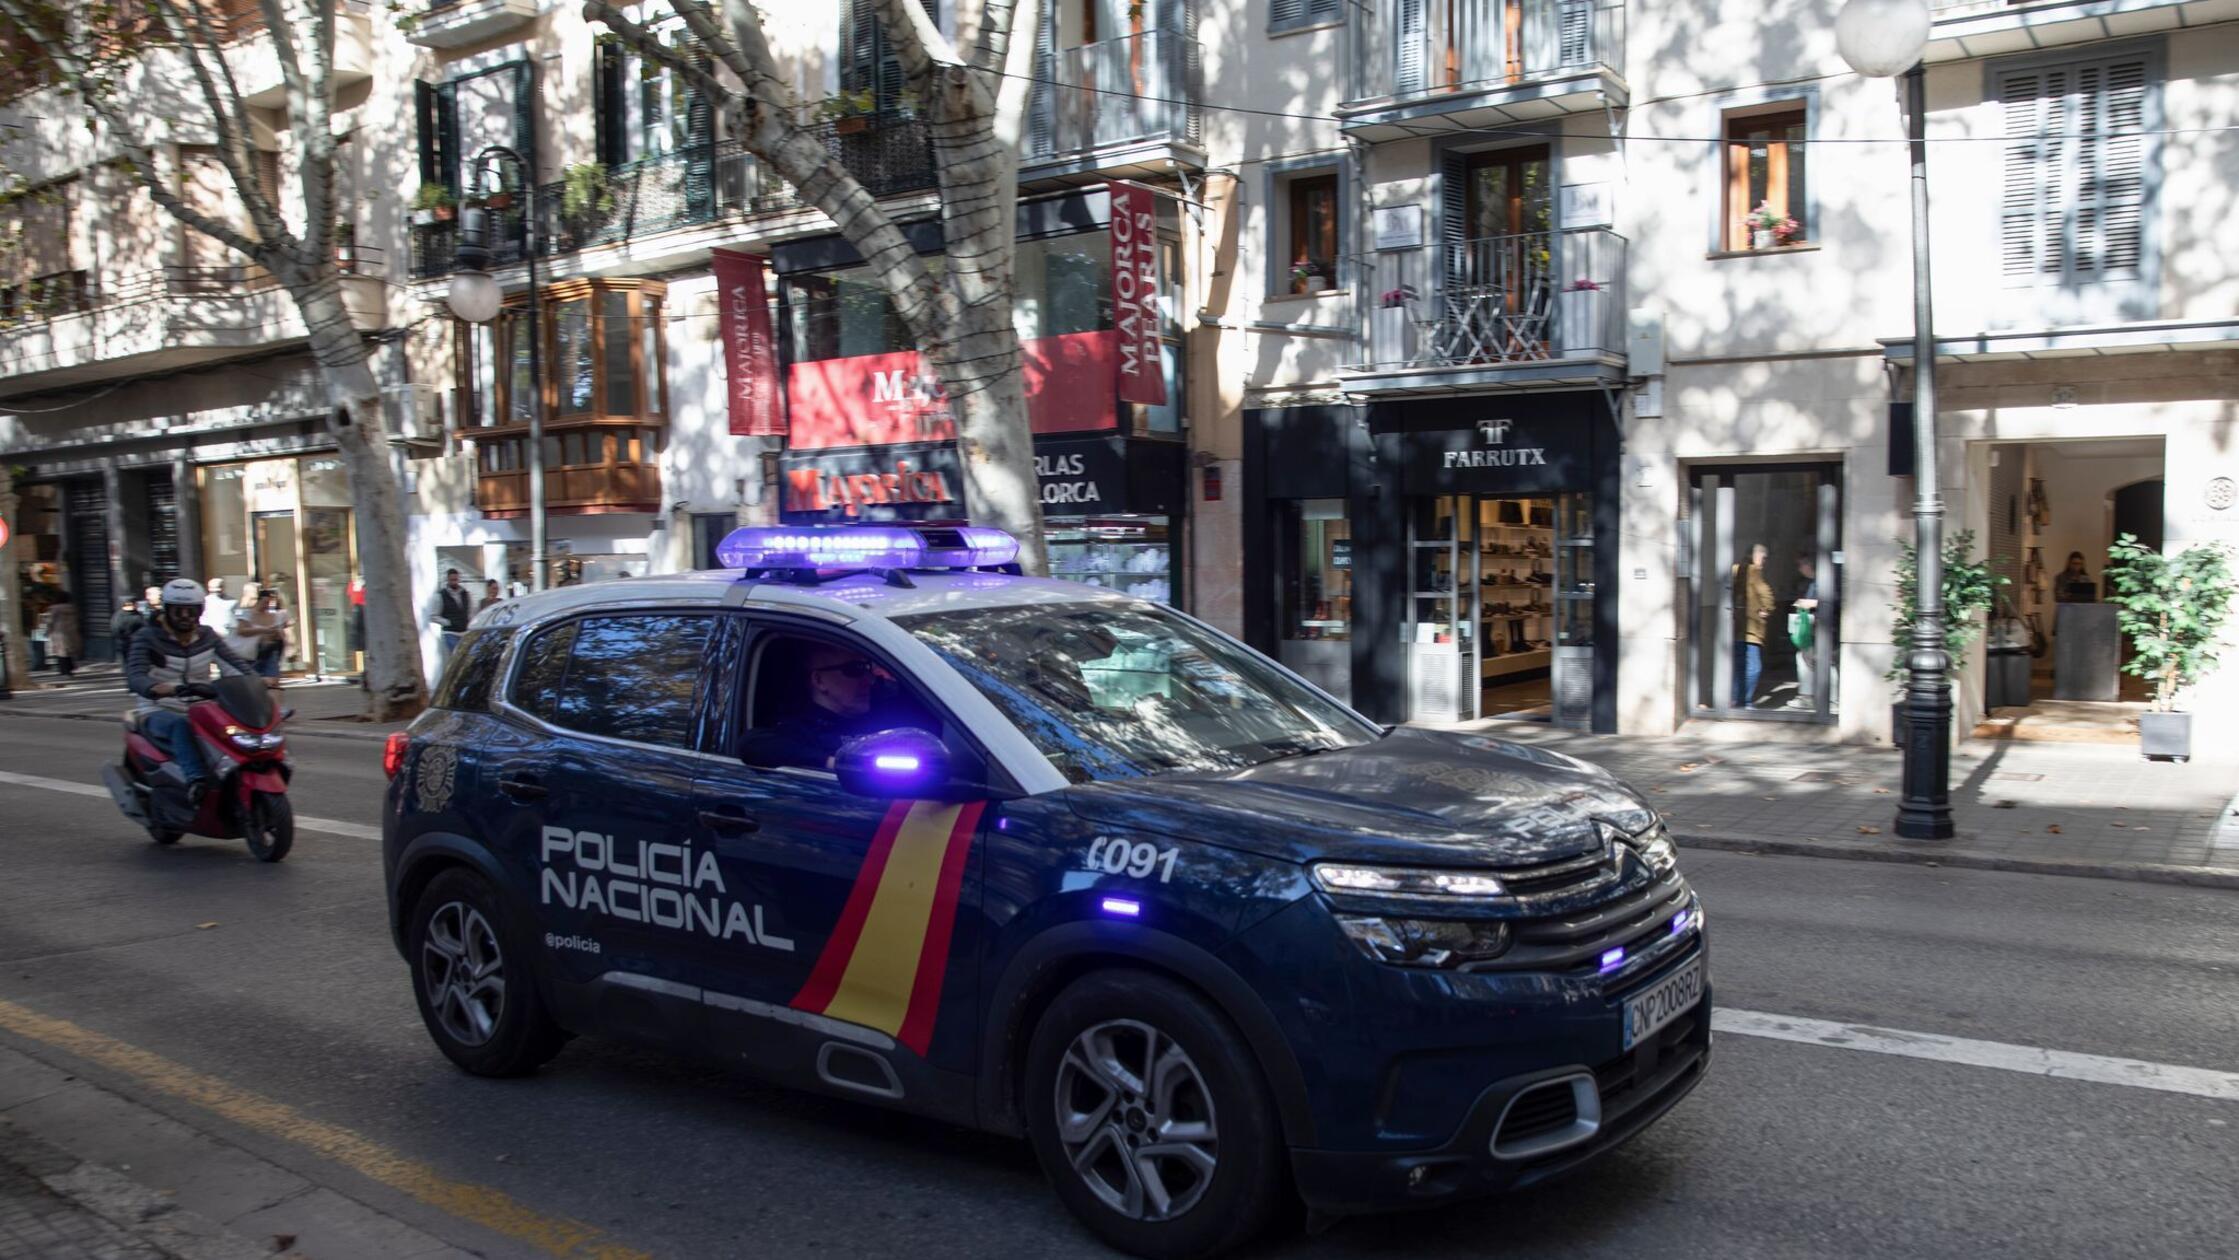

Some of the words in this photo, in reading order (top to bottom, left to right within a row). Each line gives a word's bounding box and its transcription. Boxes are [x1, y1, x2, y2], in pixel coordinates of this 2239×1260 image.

[1112, 191, 1141, 377] MAJORCA
[1135, 212, 1162, 364] PEARLS
[1443, 448, 1547, 468] FARRUTX
[541, 824, 727, 893] POLICÍA
[541, 867, 796, 952] NACIONAL
[544, 931, 601, 954] @policia
